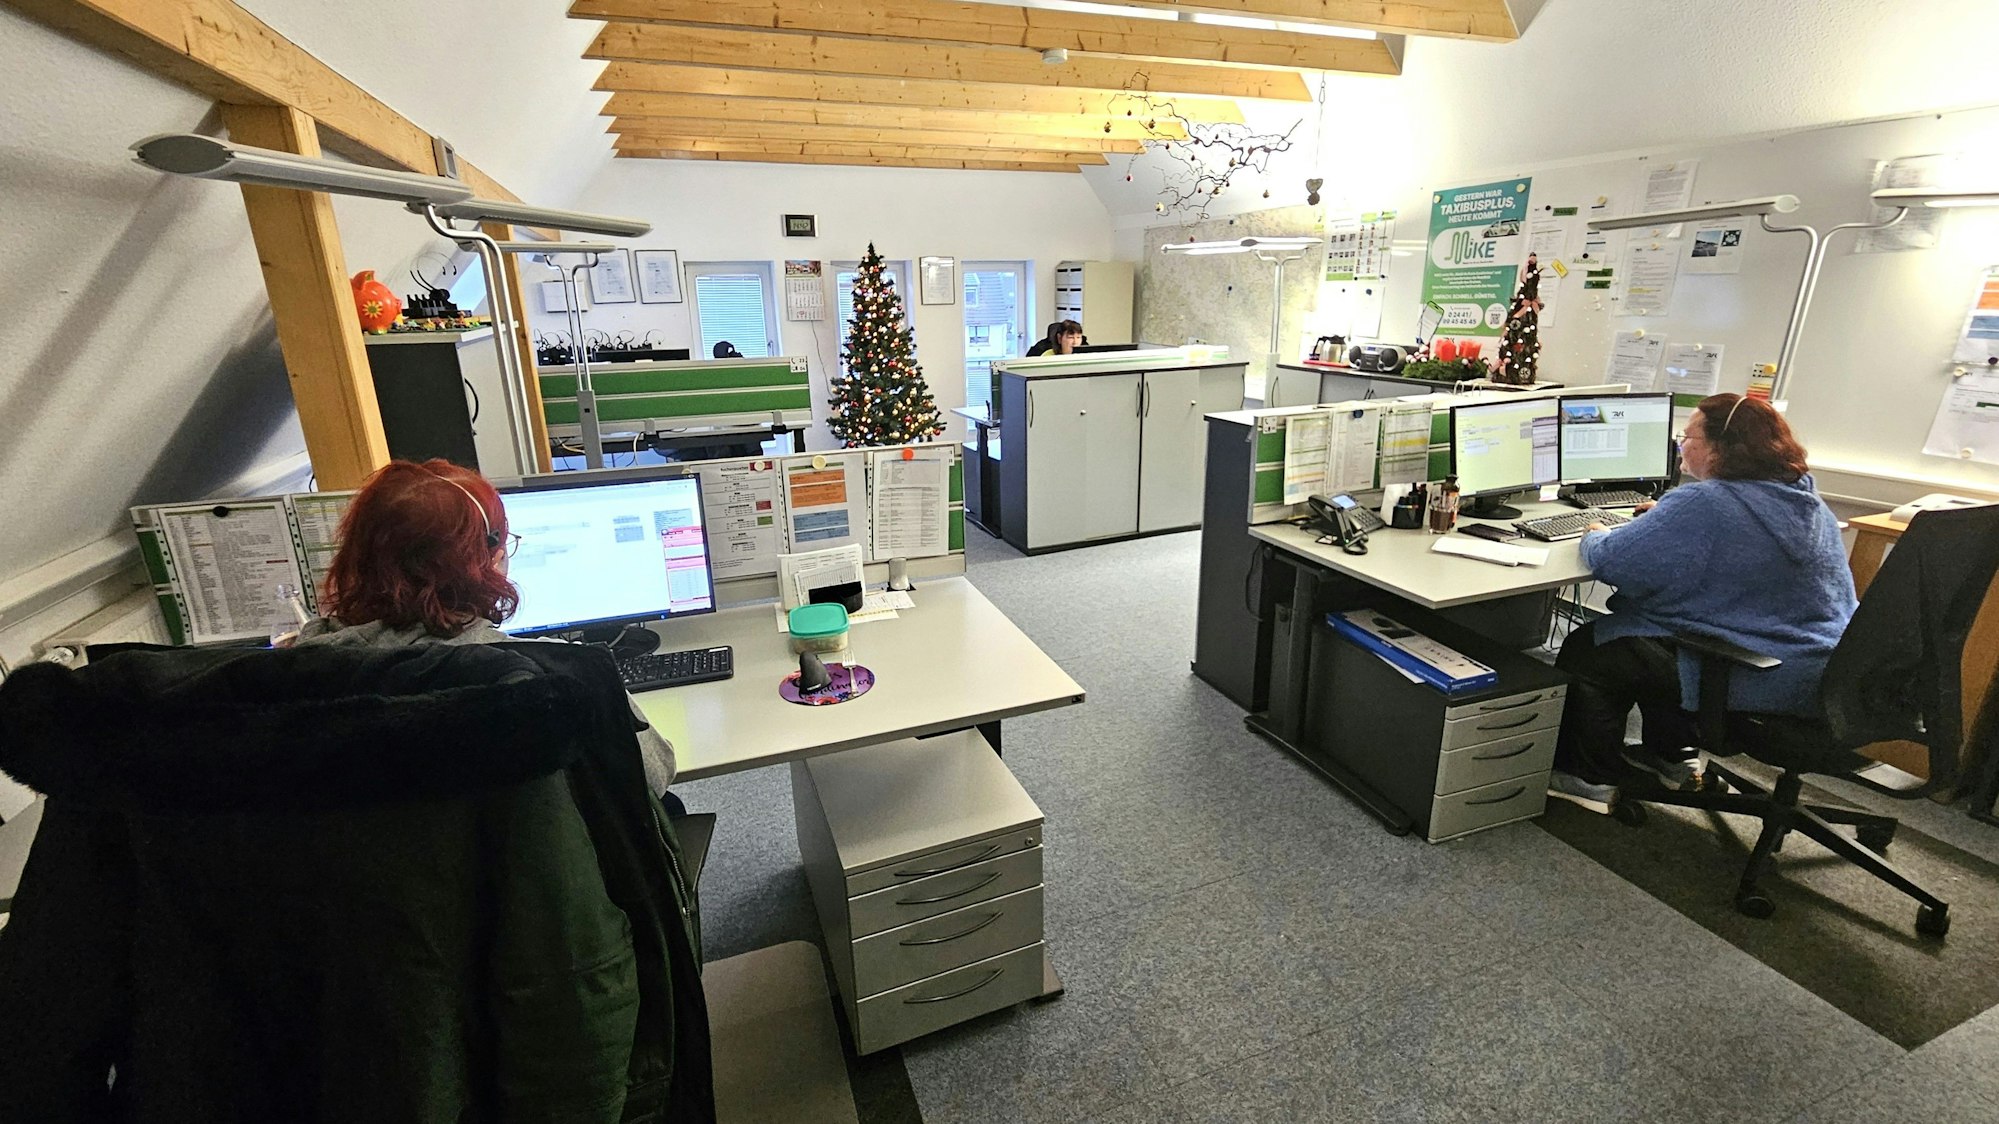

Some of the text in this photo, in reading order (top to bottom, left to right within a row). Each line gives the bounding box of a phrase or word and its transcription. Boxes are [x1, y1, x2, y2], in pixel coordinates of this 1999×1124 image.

[1454, 189, 1502, 202] GESTERN WAR
[1441, 197, 1516, 215] TAXIBUSPLUS,
[1448, 210, 1502, 223] HEUTE KOMMT
